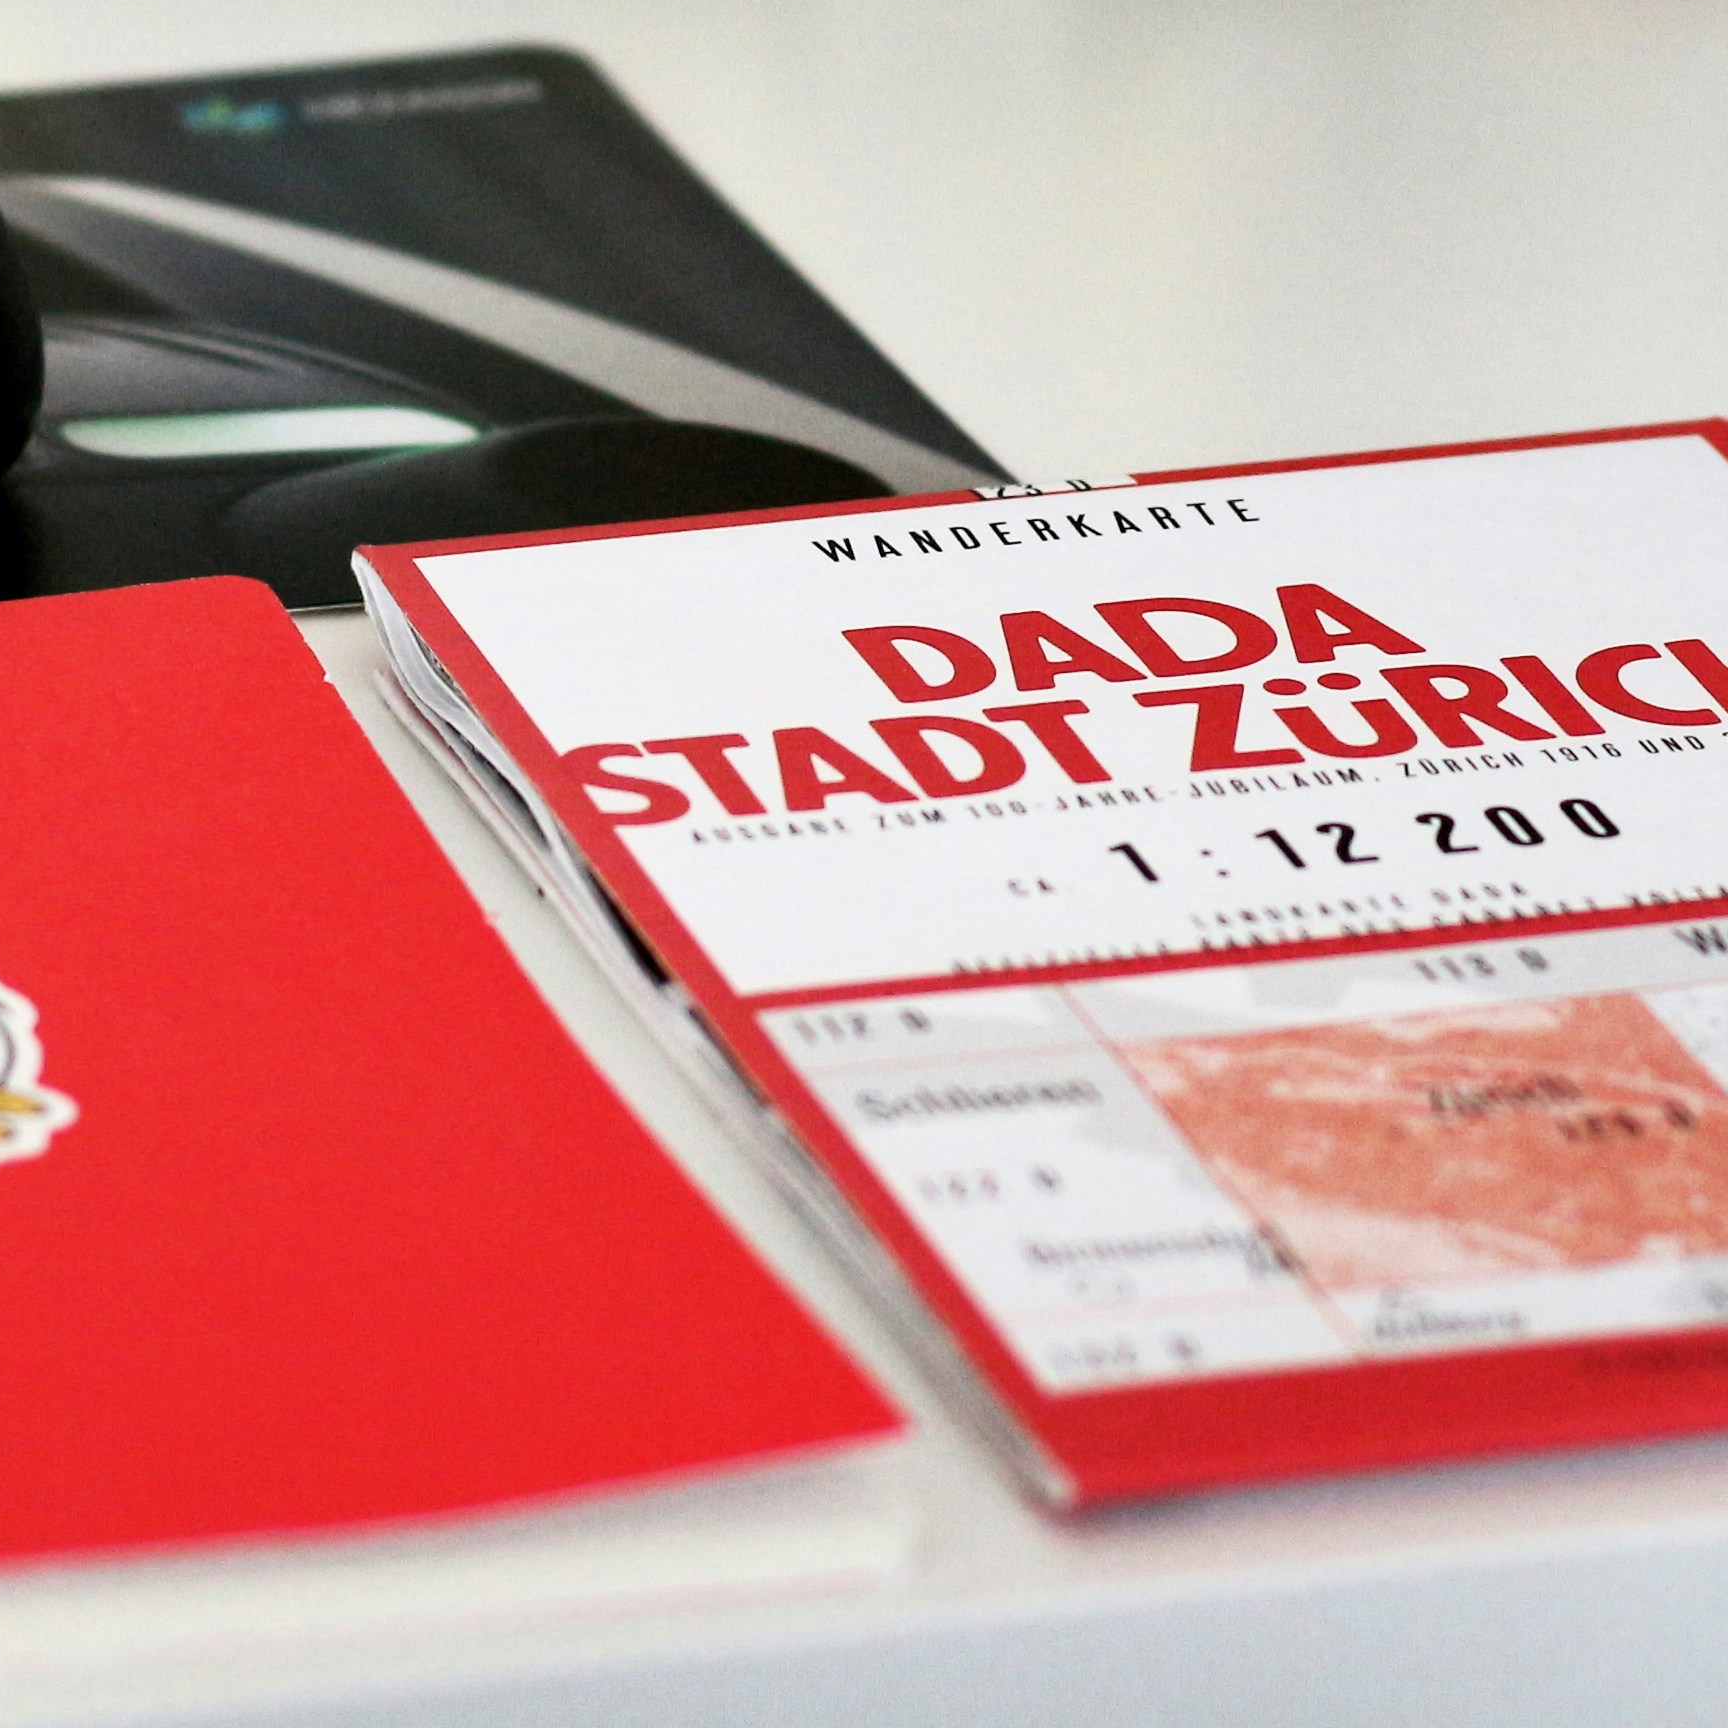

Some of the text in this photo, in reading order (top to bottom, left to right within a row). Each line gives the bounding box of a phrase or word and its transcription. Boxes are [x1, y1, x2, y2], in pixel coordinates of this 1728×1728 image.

[812, 497, 1261, 564] WANDERKARTE
[840, 582, 1427, 703] DADA
[556, 698, 1113, 828] STADT
[1539, 741, 1623, 765] 1916
[1638, 734, 1707, 756] UND
[1415, 797, 1622, 855] 200
